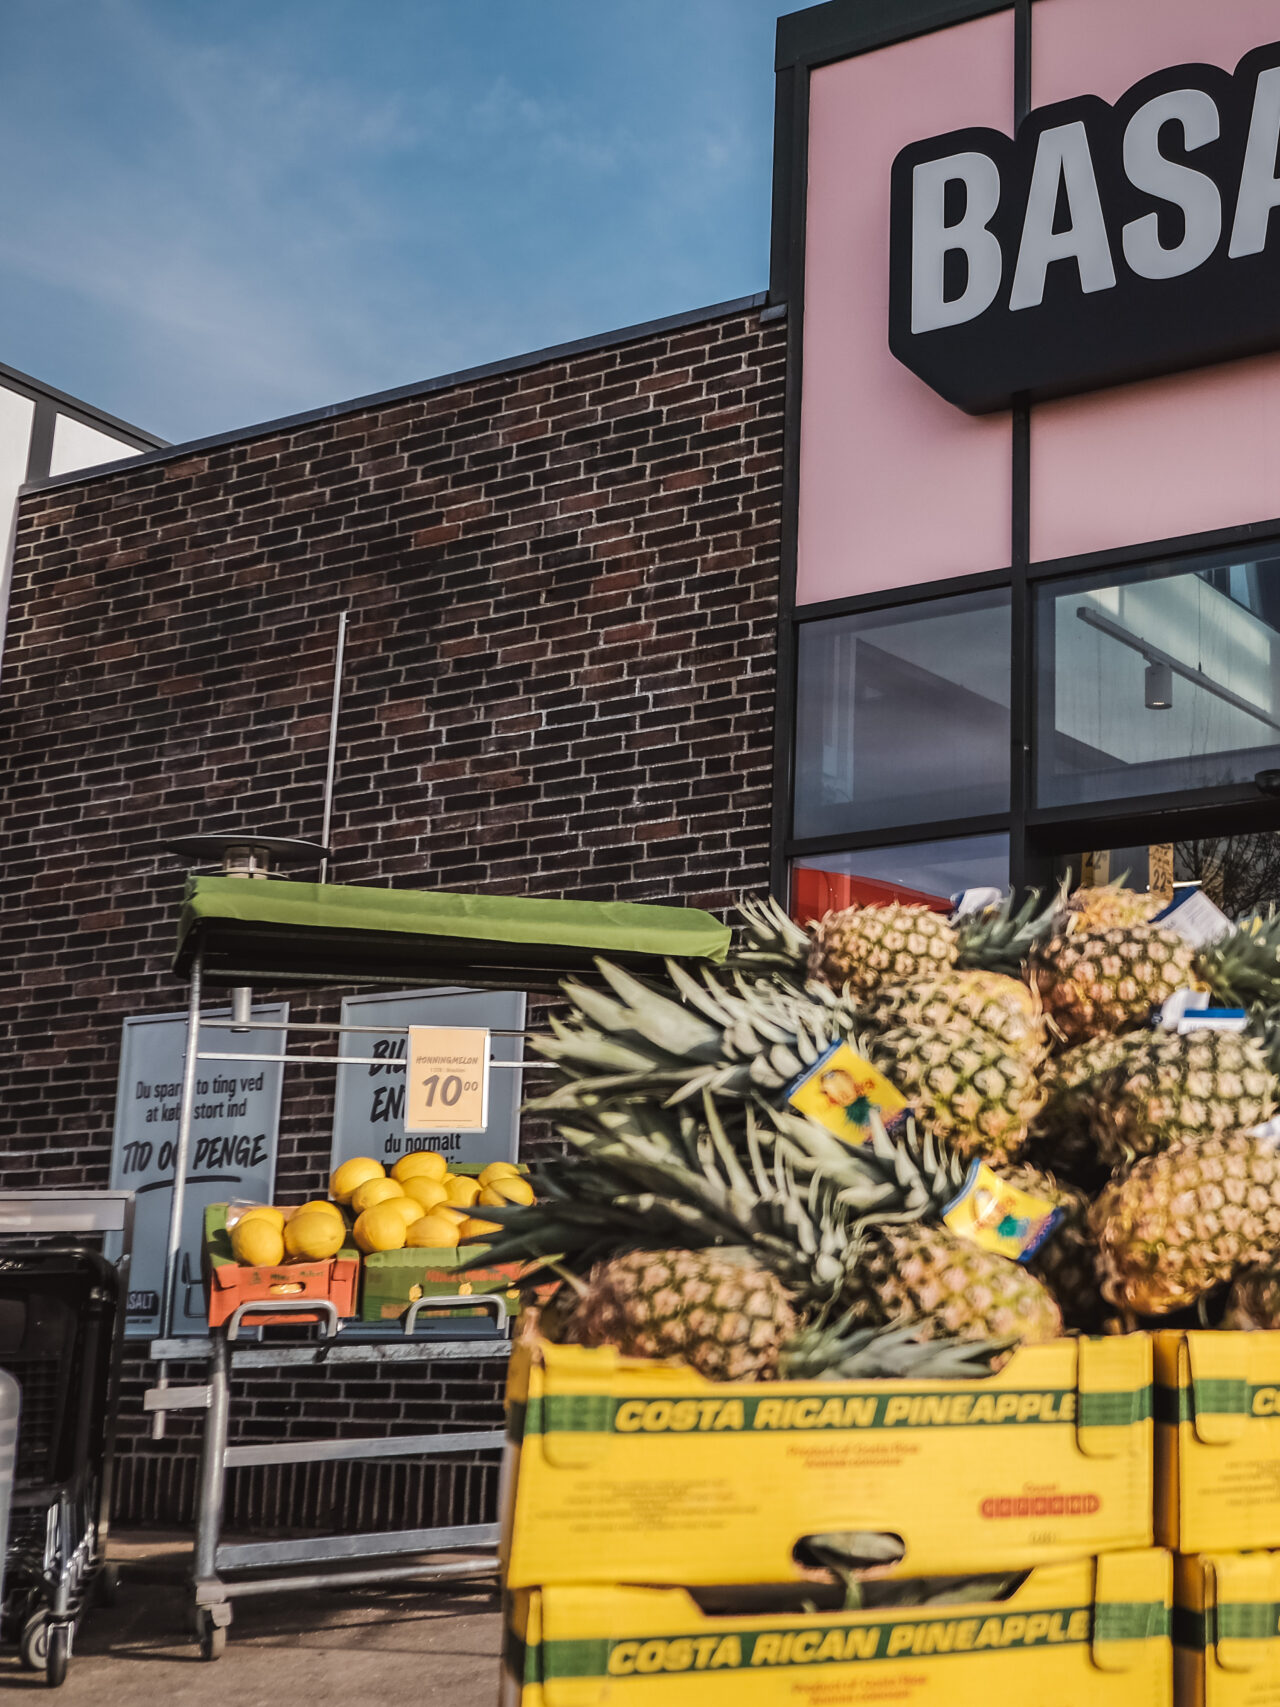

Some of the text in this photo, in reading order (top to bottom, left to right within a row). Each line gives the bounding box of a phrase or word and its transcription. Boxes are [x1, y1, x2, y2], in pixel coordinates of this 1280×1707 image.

[136, 1072, 265, 1102] Du spar to ting ved
[422, 1074, 479, 1107] 10 00
[146, 1107, 159, 1123] at
[194, 1102, 224, 1120] stort
[227, 1098, 248, 1117] ind
[123, 1140, 153, 1174] TID
[192, 1133, 268, 1170] PENGE
[384, 1132, 462, 1153] du normalt
[127, 1292, 154, 1310] SALT
[614, 1392, 1078, 1433] COSTA RICAN PINEAPPLE
[608, 1609, 1091, 1677] COSTA RICAN PINEAPPLE
